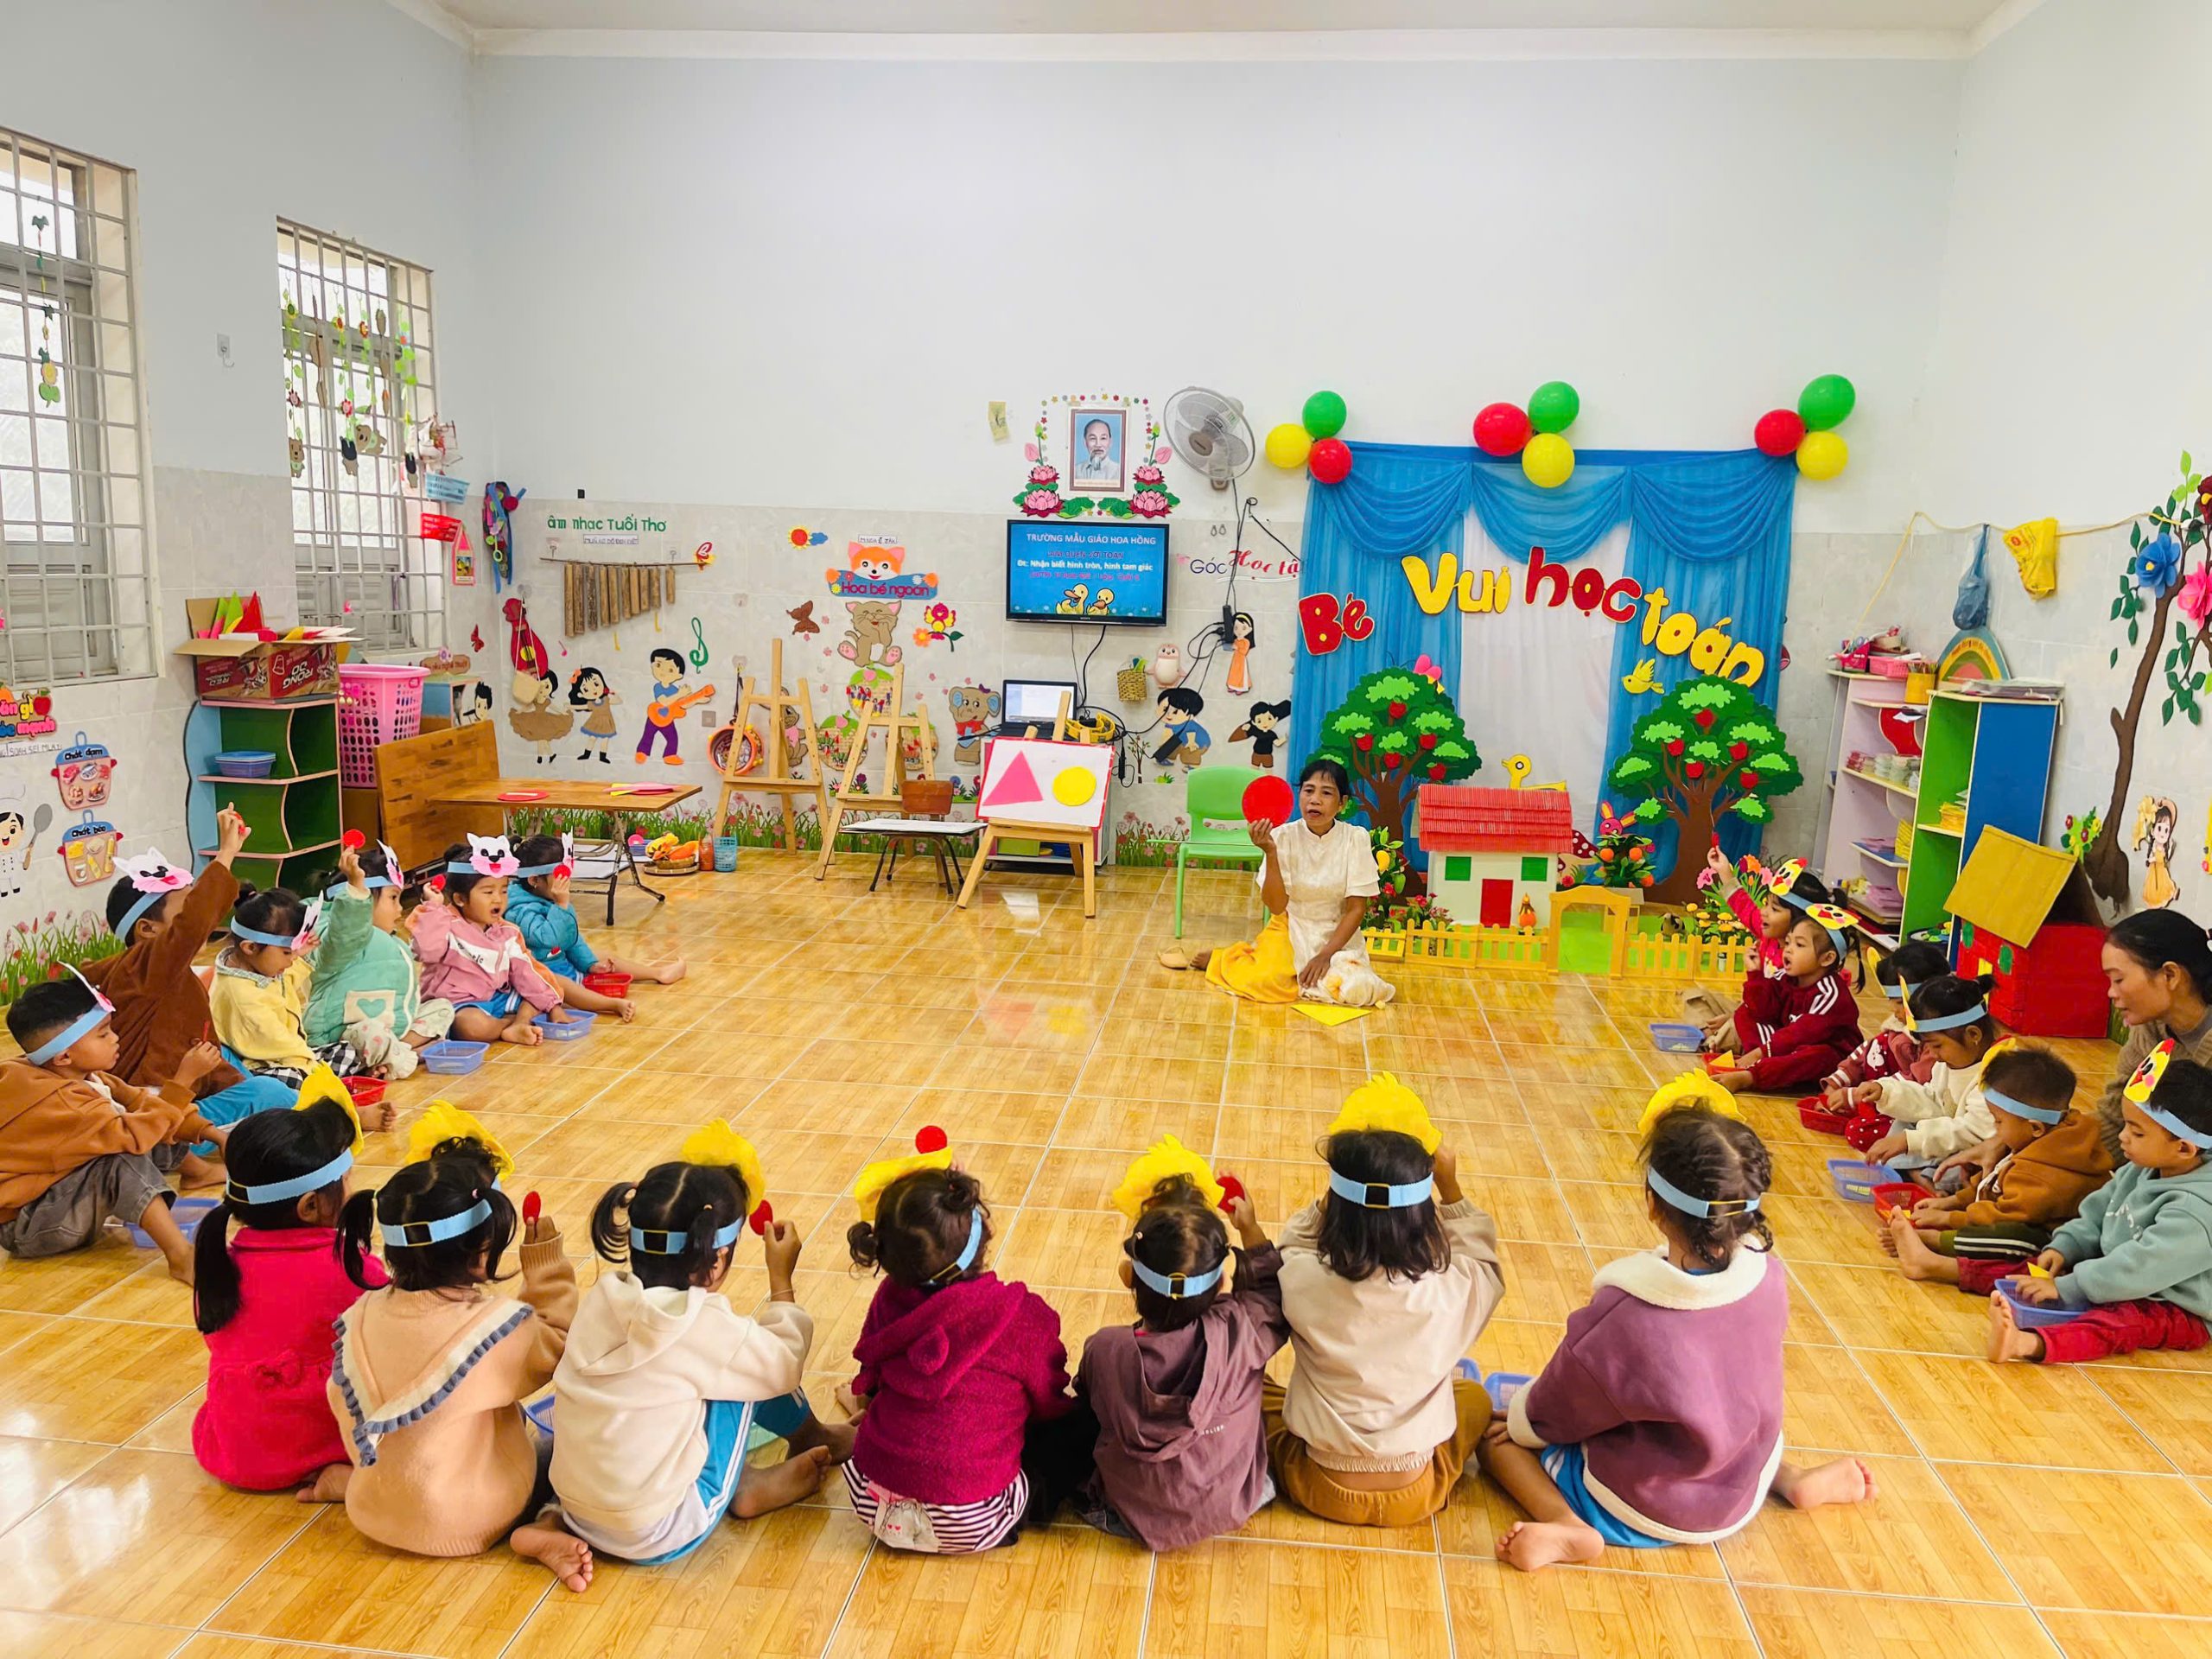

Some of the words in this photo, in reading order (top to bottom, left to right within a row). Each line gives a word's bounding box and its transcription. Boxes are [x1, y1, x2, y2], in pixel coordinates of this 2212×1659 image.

[641, 517, 667, 532] Thơ
[1027, 532, 1063, 542] TRƯỜNG
[1065, 531, 1085, 543] MẪU
[1087, 533, 1109, 543] GIÁO
[1110, 536, 1129, 544] HOA
[1130, 534, 1157, 545] HỒNG
[1278, 558, 1300, 578] tậ
[842, 582, 867, 594] Hoa
[870, 582, 887, 595] bé
[1299, 593, 1375, 656] Bé
[1401, 552, 1512, 615] Vui
[1525, 546, 1642, 624] học
[1641, 587, 1764, 688] toán
